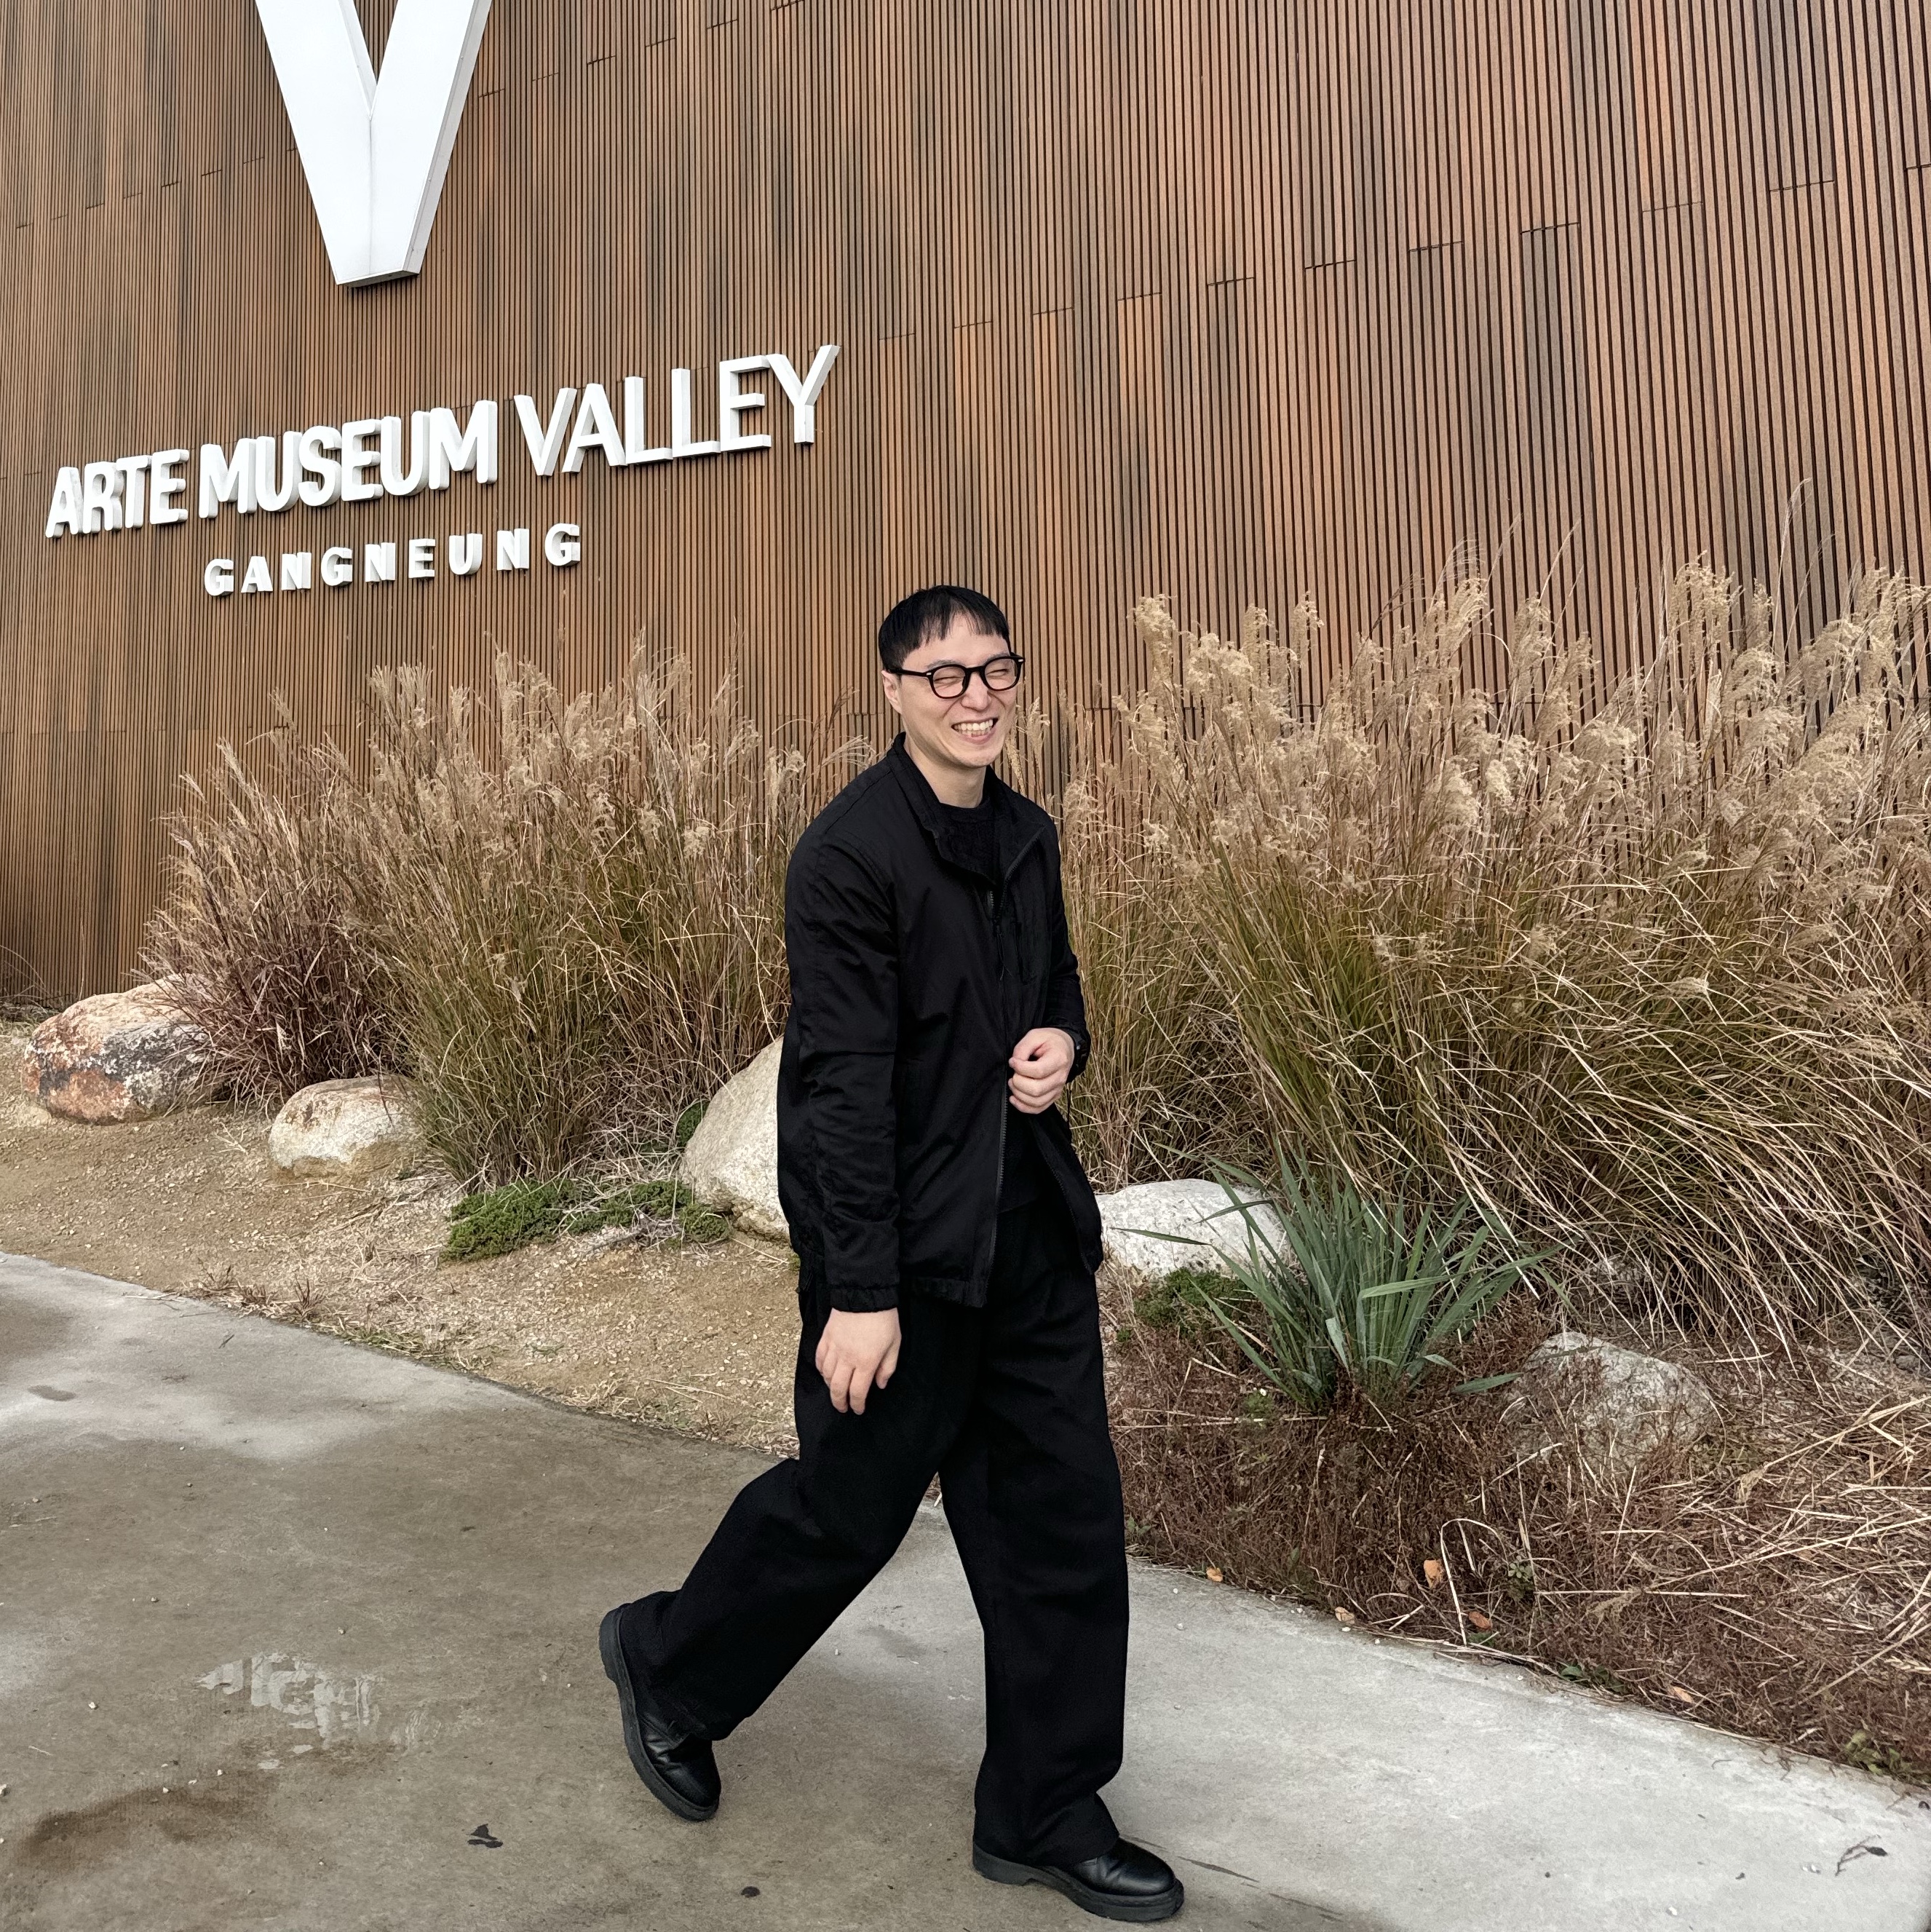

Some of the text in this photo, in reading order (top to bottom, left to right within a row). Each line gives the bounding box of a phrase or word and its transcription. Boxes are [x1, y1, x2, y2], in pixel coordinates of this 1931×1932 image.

[44, 343, 841, 539] ARTE MUSEUM VALLEY
[204, 522, 582, 596] GANGNEUNG
